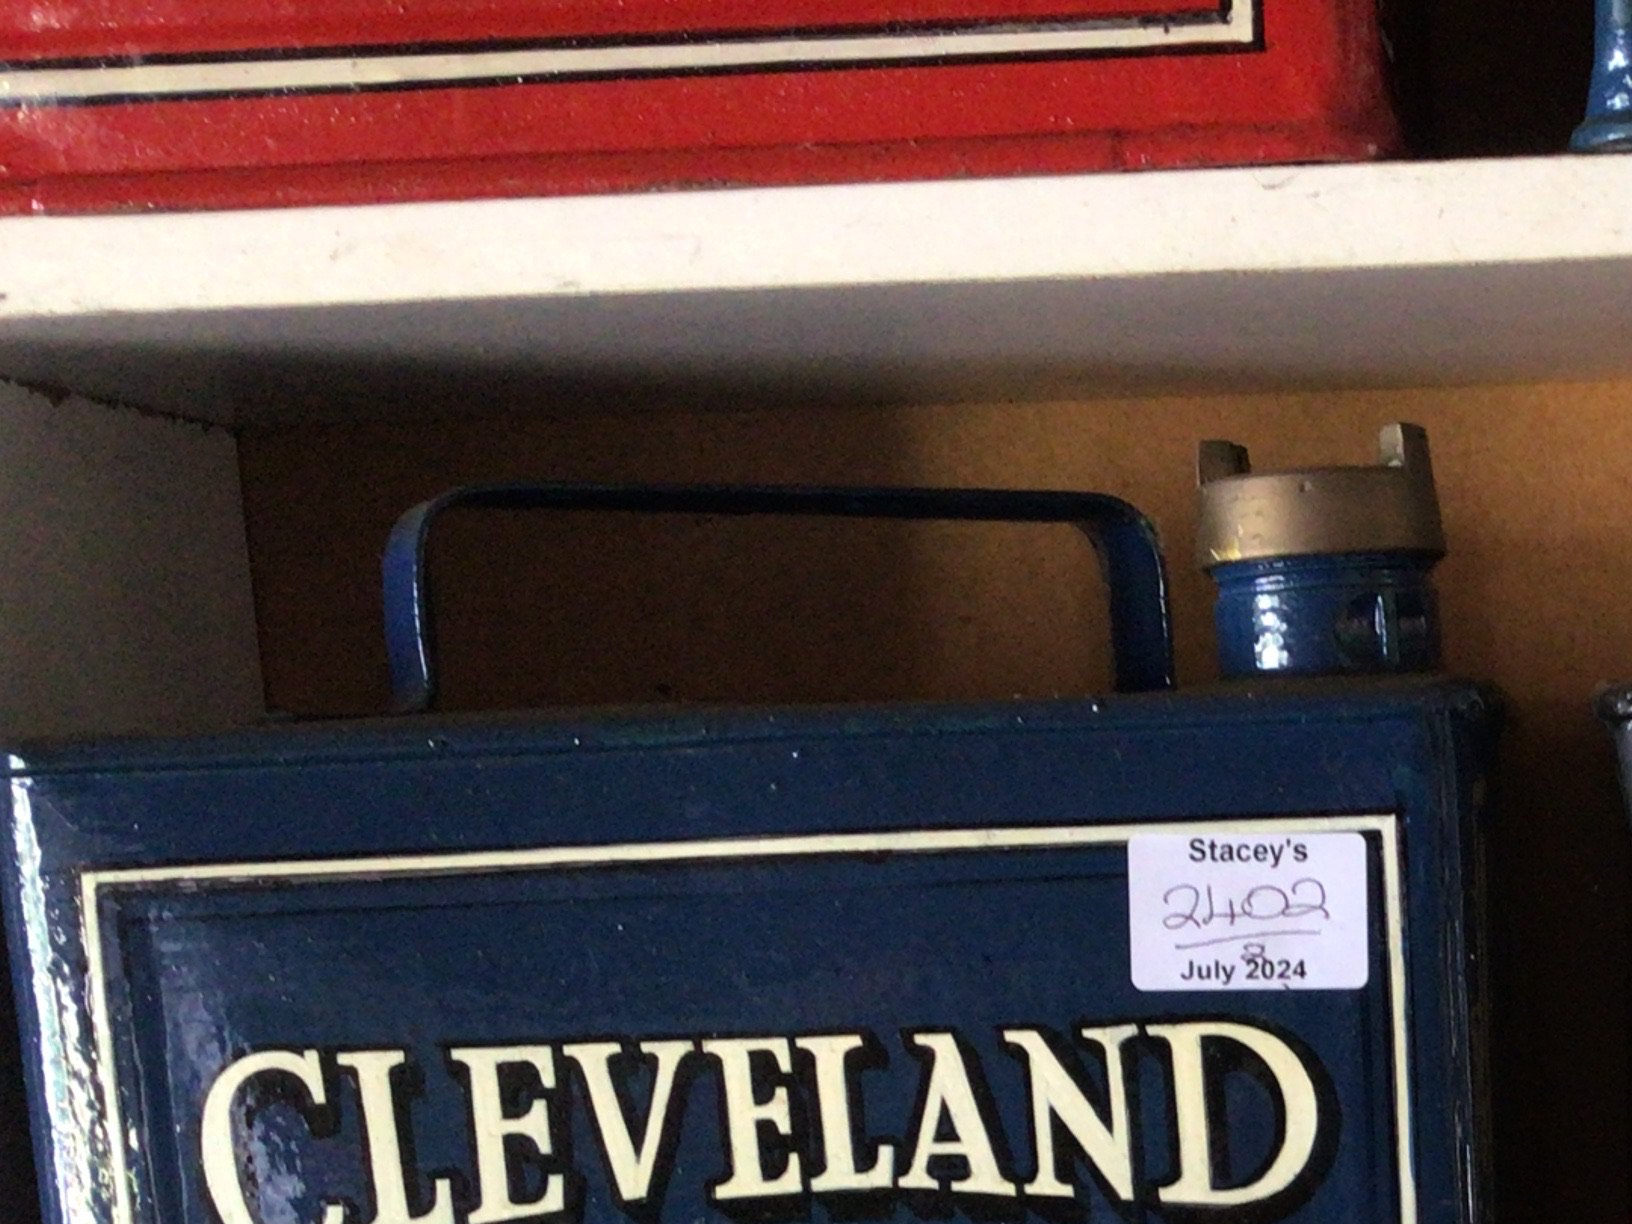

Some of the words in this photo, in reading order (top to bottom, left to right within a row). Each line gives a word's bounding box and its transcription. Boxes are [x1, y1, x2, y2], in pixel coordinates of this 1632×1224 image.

[1188, 838, 1309, 868] Stacey's
[1162, 877, 1330, 930] 2402
[1180, 959, 1236, 985] July
[1245, 959, 1308, 981] 2024
